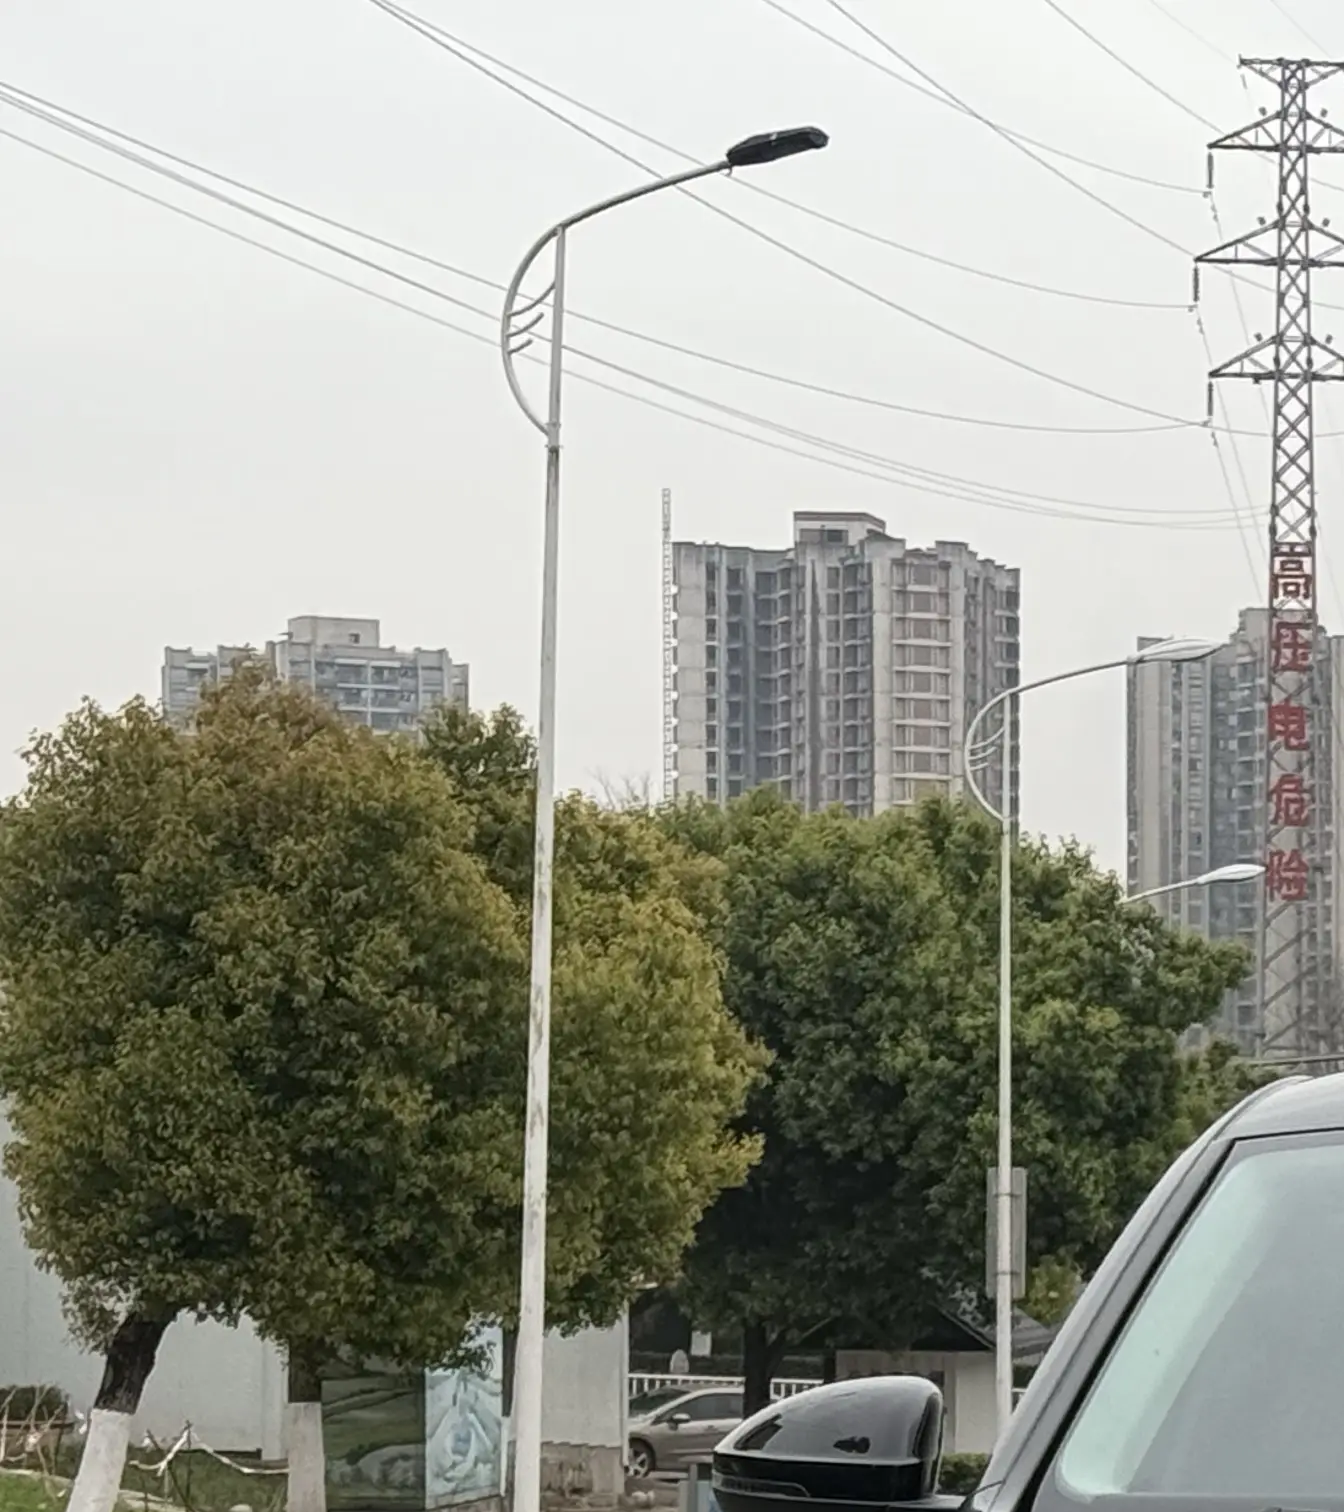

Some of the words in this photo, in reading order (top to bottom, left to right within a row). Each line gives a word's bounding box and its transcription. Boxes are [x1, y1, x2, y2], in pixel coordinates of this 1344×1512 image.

[1266, 542, 1314, 901] 高压电危险
